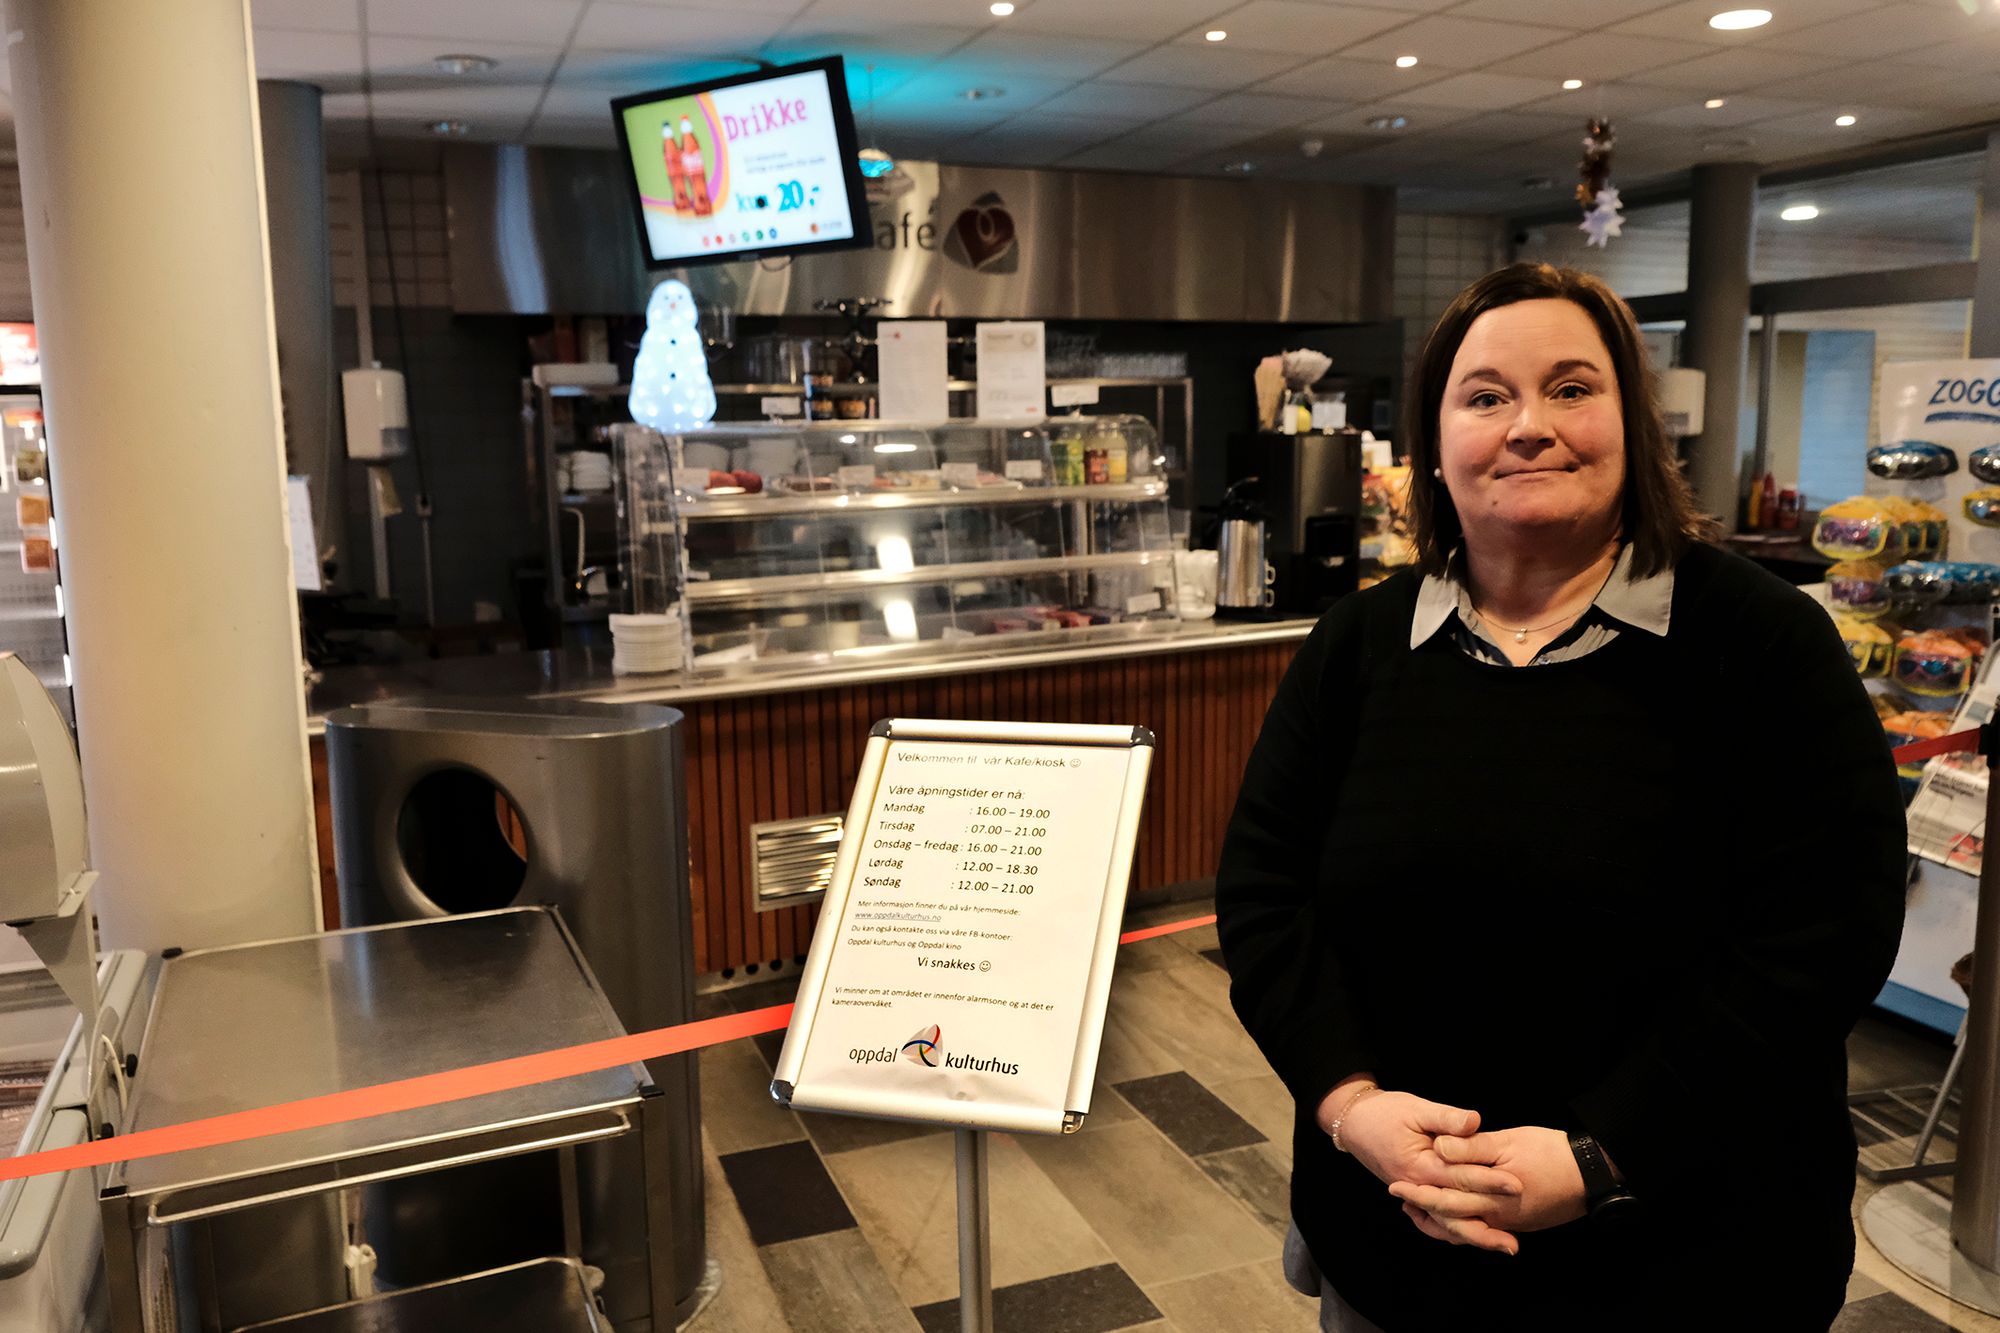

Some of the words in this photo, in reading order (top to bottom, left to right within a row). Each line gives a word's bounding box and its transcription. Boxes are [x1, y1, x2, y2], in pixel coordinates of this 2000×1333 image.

[723, 96, 809, 142] Drikke
[898, 753, 963, 763] Velkommen
[967, 756, 977, 764] til
[984, 757, 1002, 765] vår
[889, 786, 914, 795] Våre
[917, 786, 988, 798] åpningstider
[884, 804, 925, 814] Mandag
[977, 807, 1006, 816] 16.00
[1020, 809, 1050, 818] 19.00
[880, 821, 915, 832] Tirsdag
[971, 825, 1002, 835] 07.00
[1015, 827, 1046, 837] 21.00
[874, 840, 911, 851] Onsdag
[924, 840, 959, 853] fredag
[967, 843, 998, 853] 16.00
[1010, 845, 1042, 856] 21.00
[869, 858, 903, 869] Lørdag
[963, 862, 993, 872] 12.00
[1007, 864, 1038, 875] 18.30
[864, 877, 901, 888] Søndag
[958, 881, 989, 891] 12.00
[1002, 883, 1033, 894] 21.00
[873, 901, 913, 909] informasjon
[918, 941, 944, 949] Oppdal
[918, 957, 928, 966] Vi
[931, 959, 975, 970] snakkes
[891, 990, 922, 998] området
[933, 993, 965, 1001] innenfor
[967, 995, 1007, 1006] alarmsone
[1009, 1001, 1019, 1009] og
[849, 1047, 898, 1064] oppdal
[945, 1052, 1018, 1075] kulturhus
